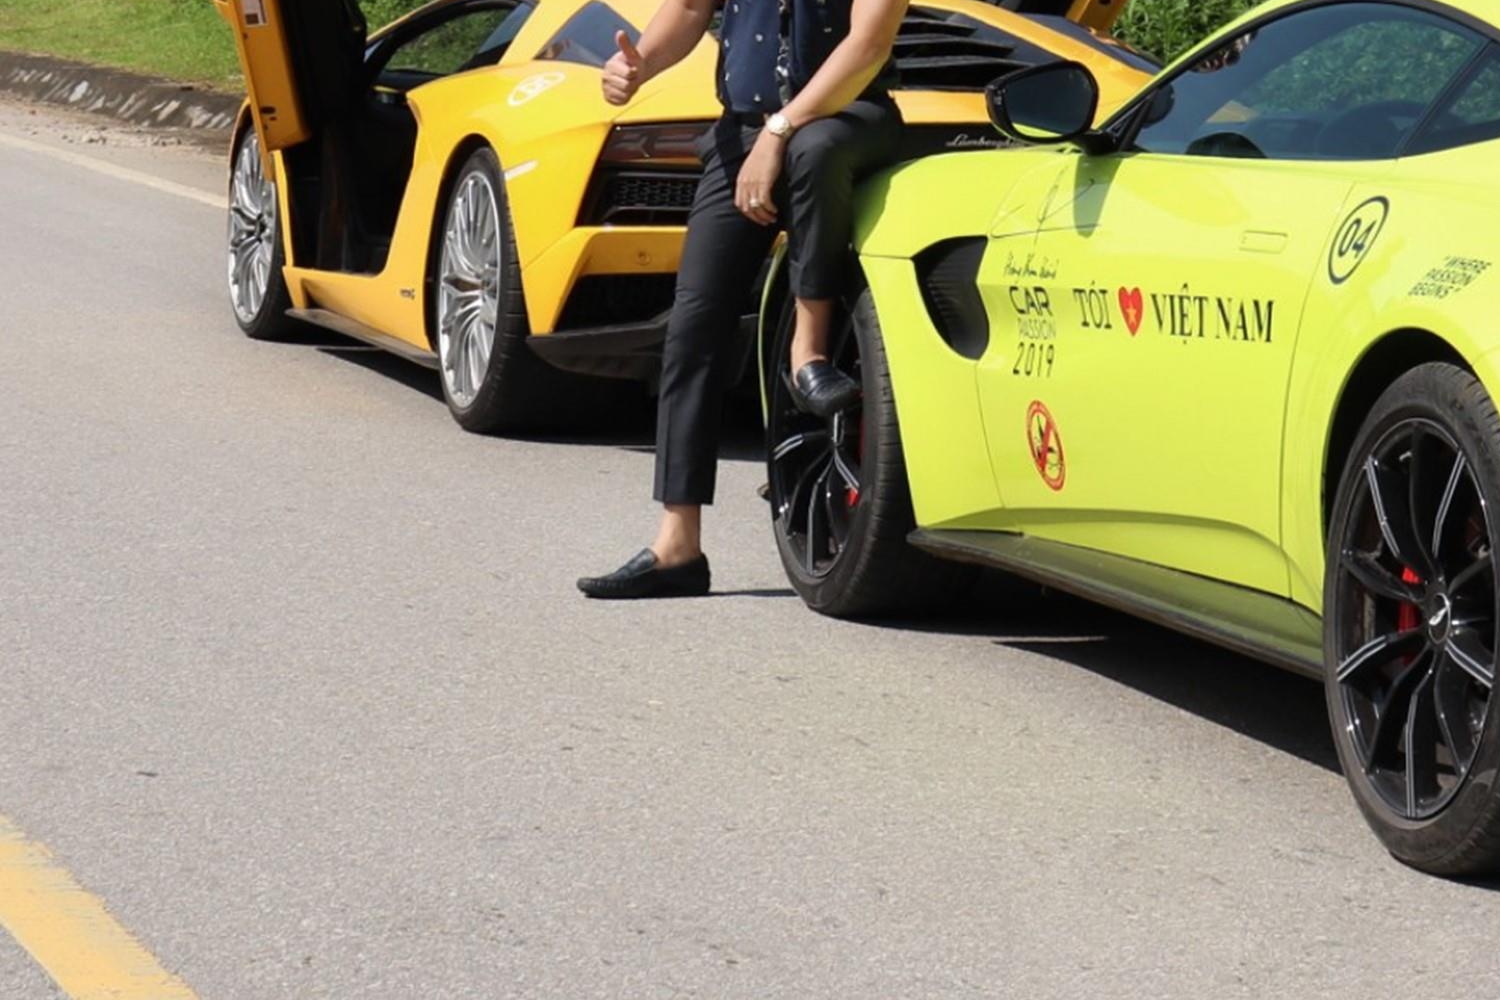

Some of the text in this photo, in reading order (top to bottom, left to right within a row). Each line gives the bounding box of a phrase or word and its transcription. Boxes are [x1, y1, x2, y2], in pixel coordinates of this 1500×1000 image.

[1338, 217, 1377, 259] 04
[1009, 286, 1053, 316] CAR
[1150, 283, 1209, 345] VIỆT
[1215, 297, 1275, 343] NAM
[1012, 341, 1055, 377] 2019
